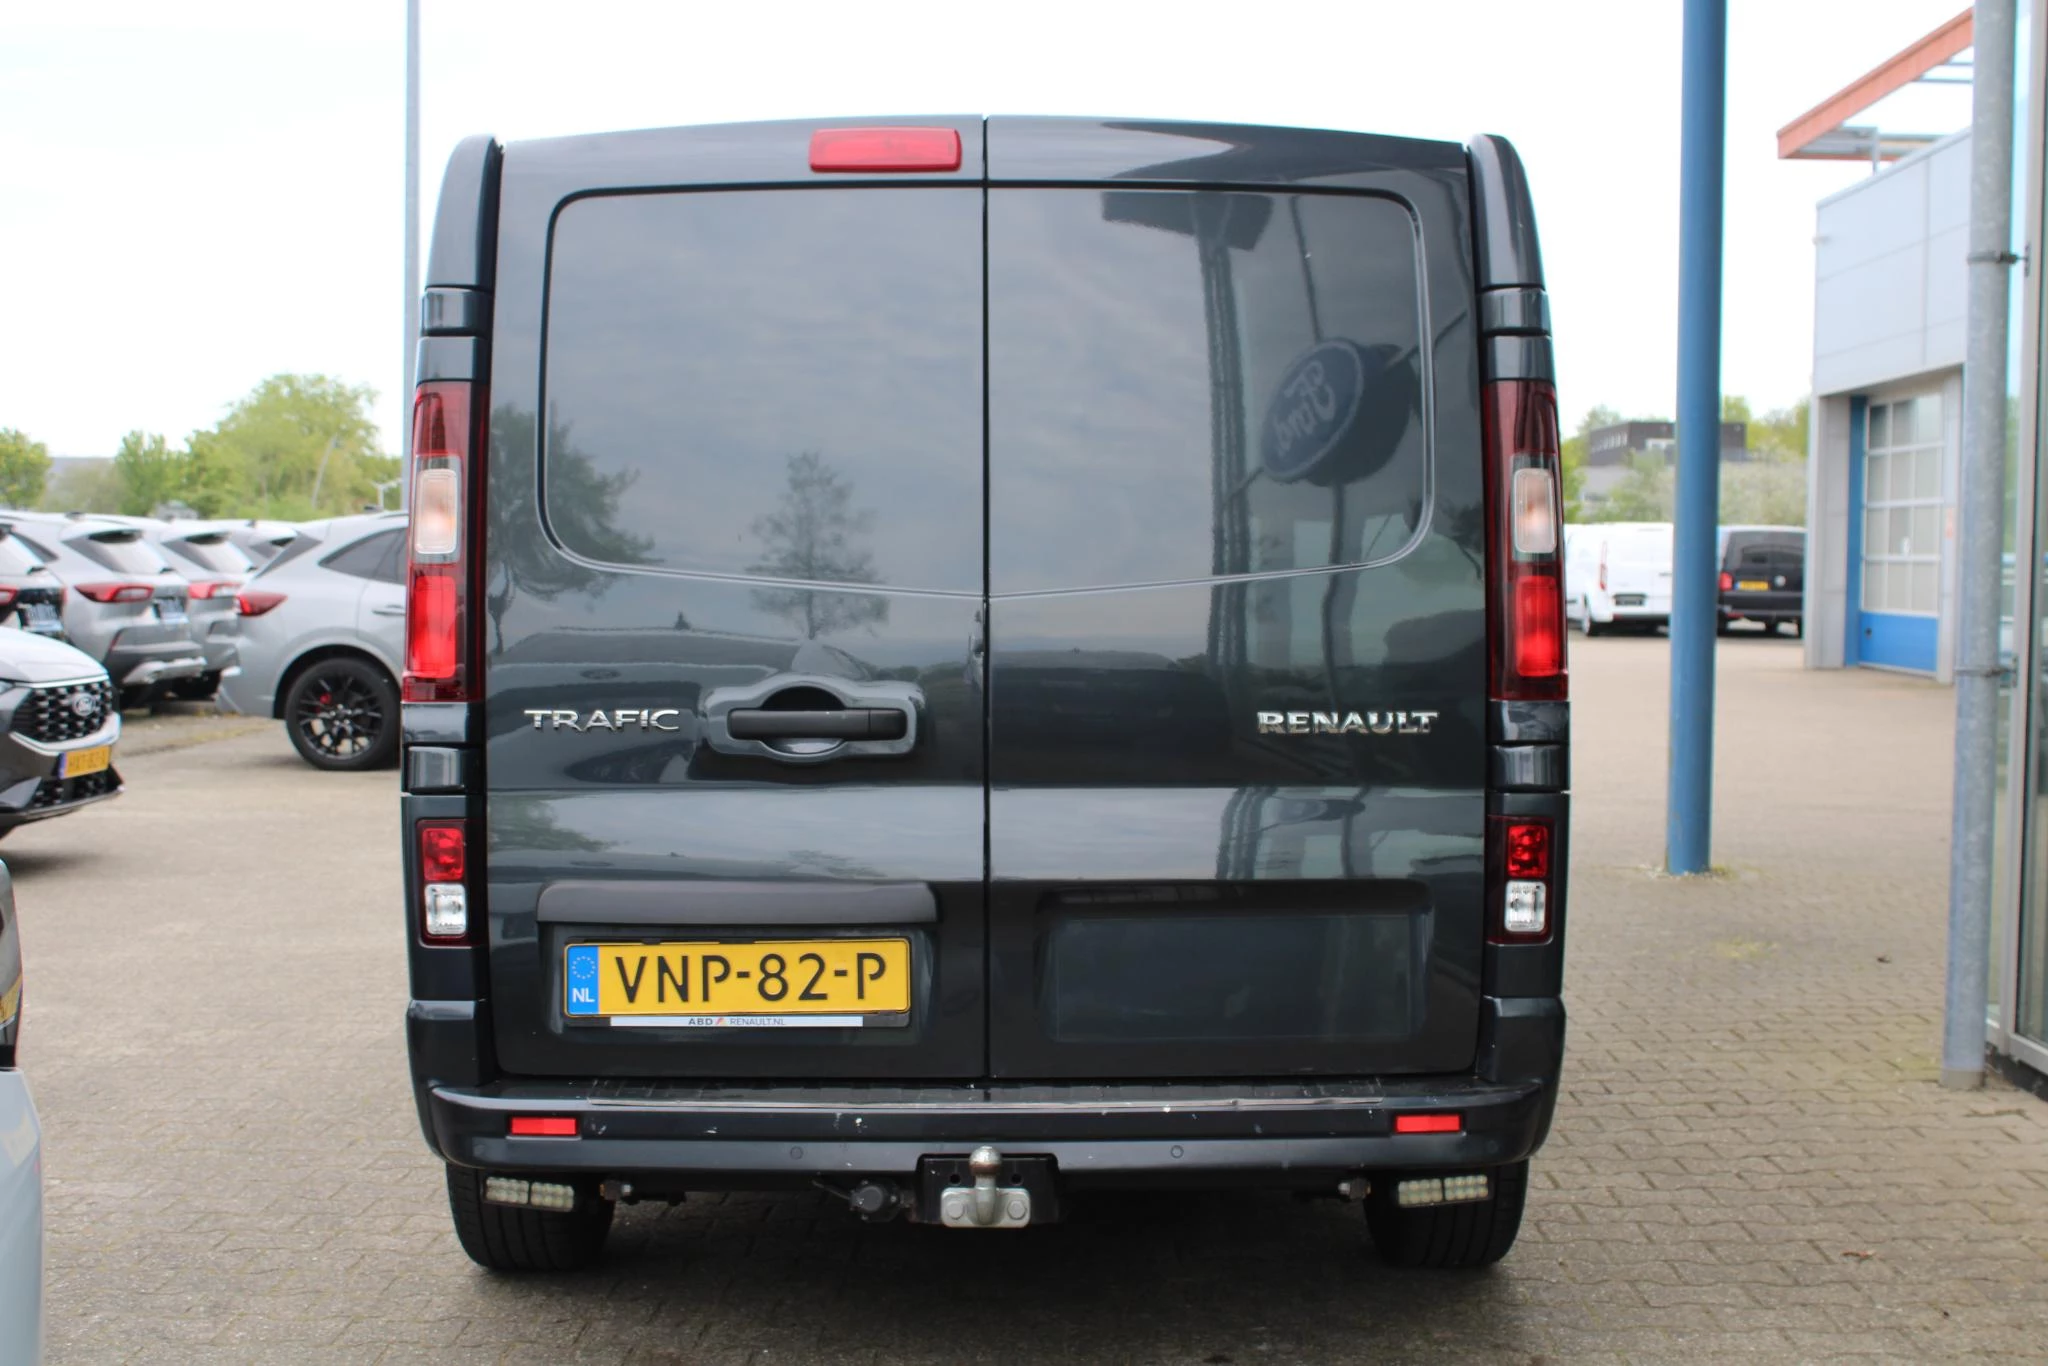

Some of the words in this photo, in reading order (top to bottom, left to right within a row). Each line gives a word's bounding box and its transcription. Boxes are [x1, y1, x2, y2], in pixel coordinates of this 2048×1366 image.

[523, 709, 680, 732] TRAFIC
[1256, 711, 1440, 734] RENAULT
[615, 952, 887, 1004] VNP-82-P
[572, 987, 595, 1003] NL
[688, 1017, 714, 1027] ABD
[729, 1017, 786, 1026] RENAULT.NL
